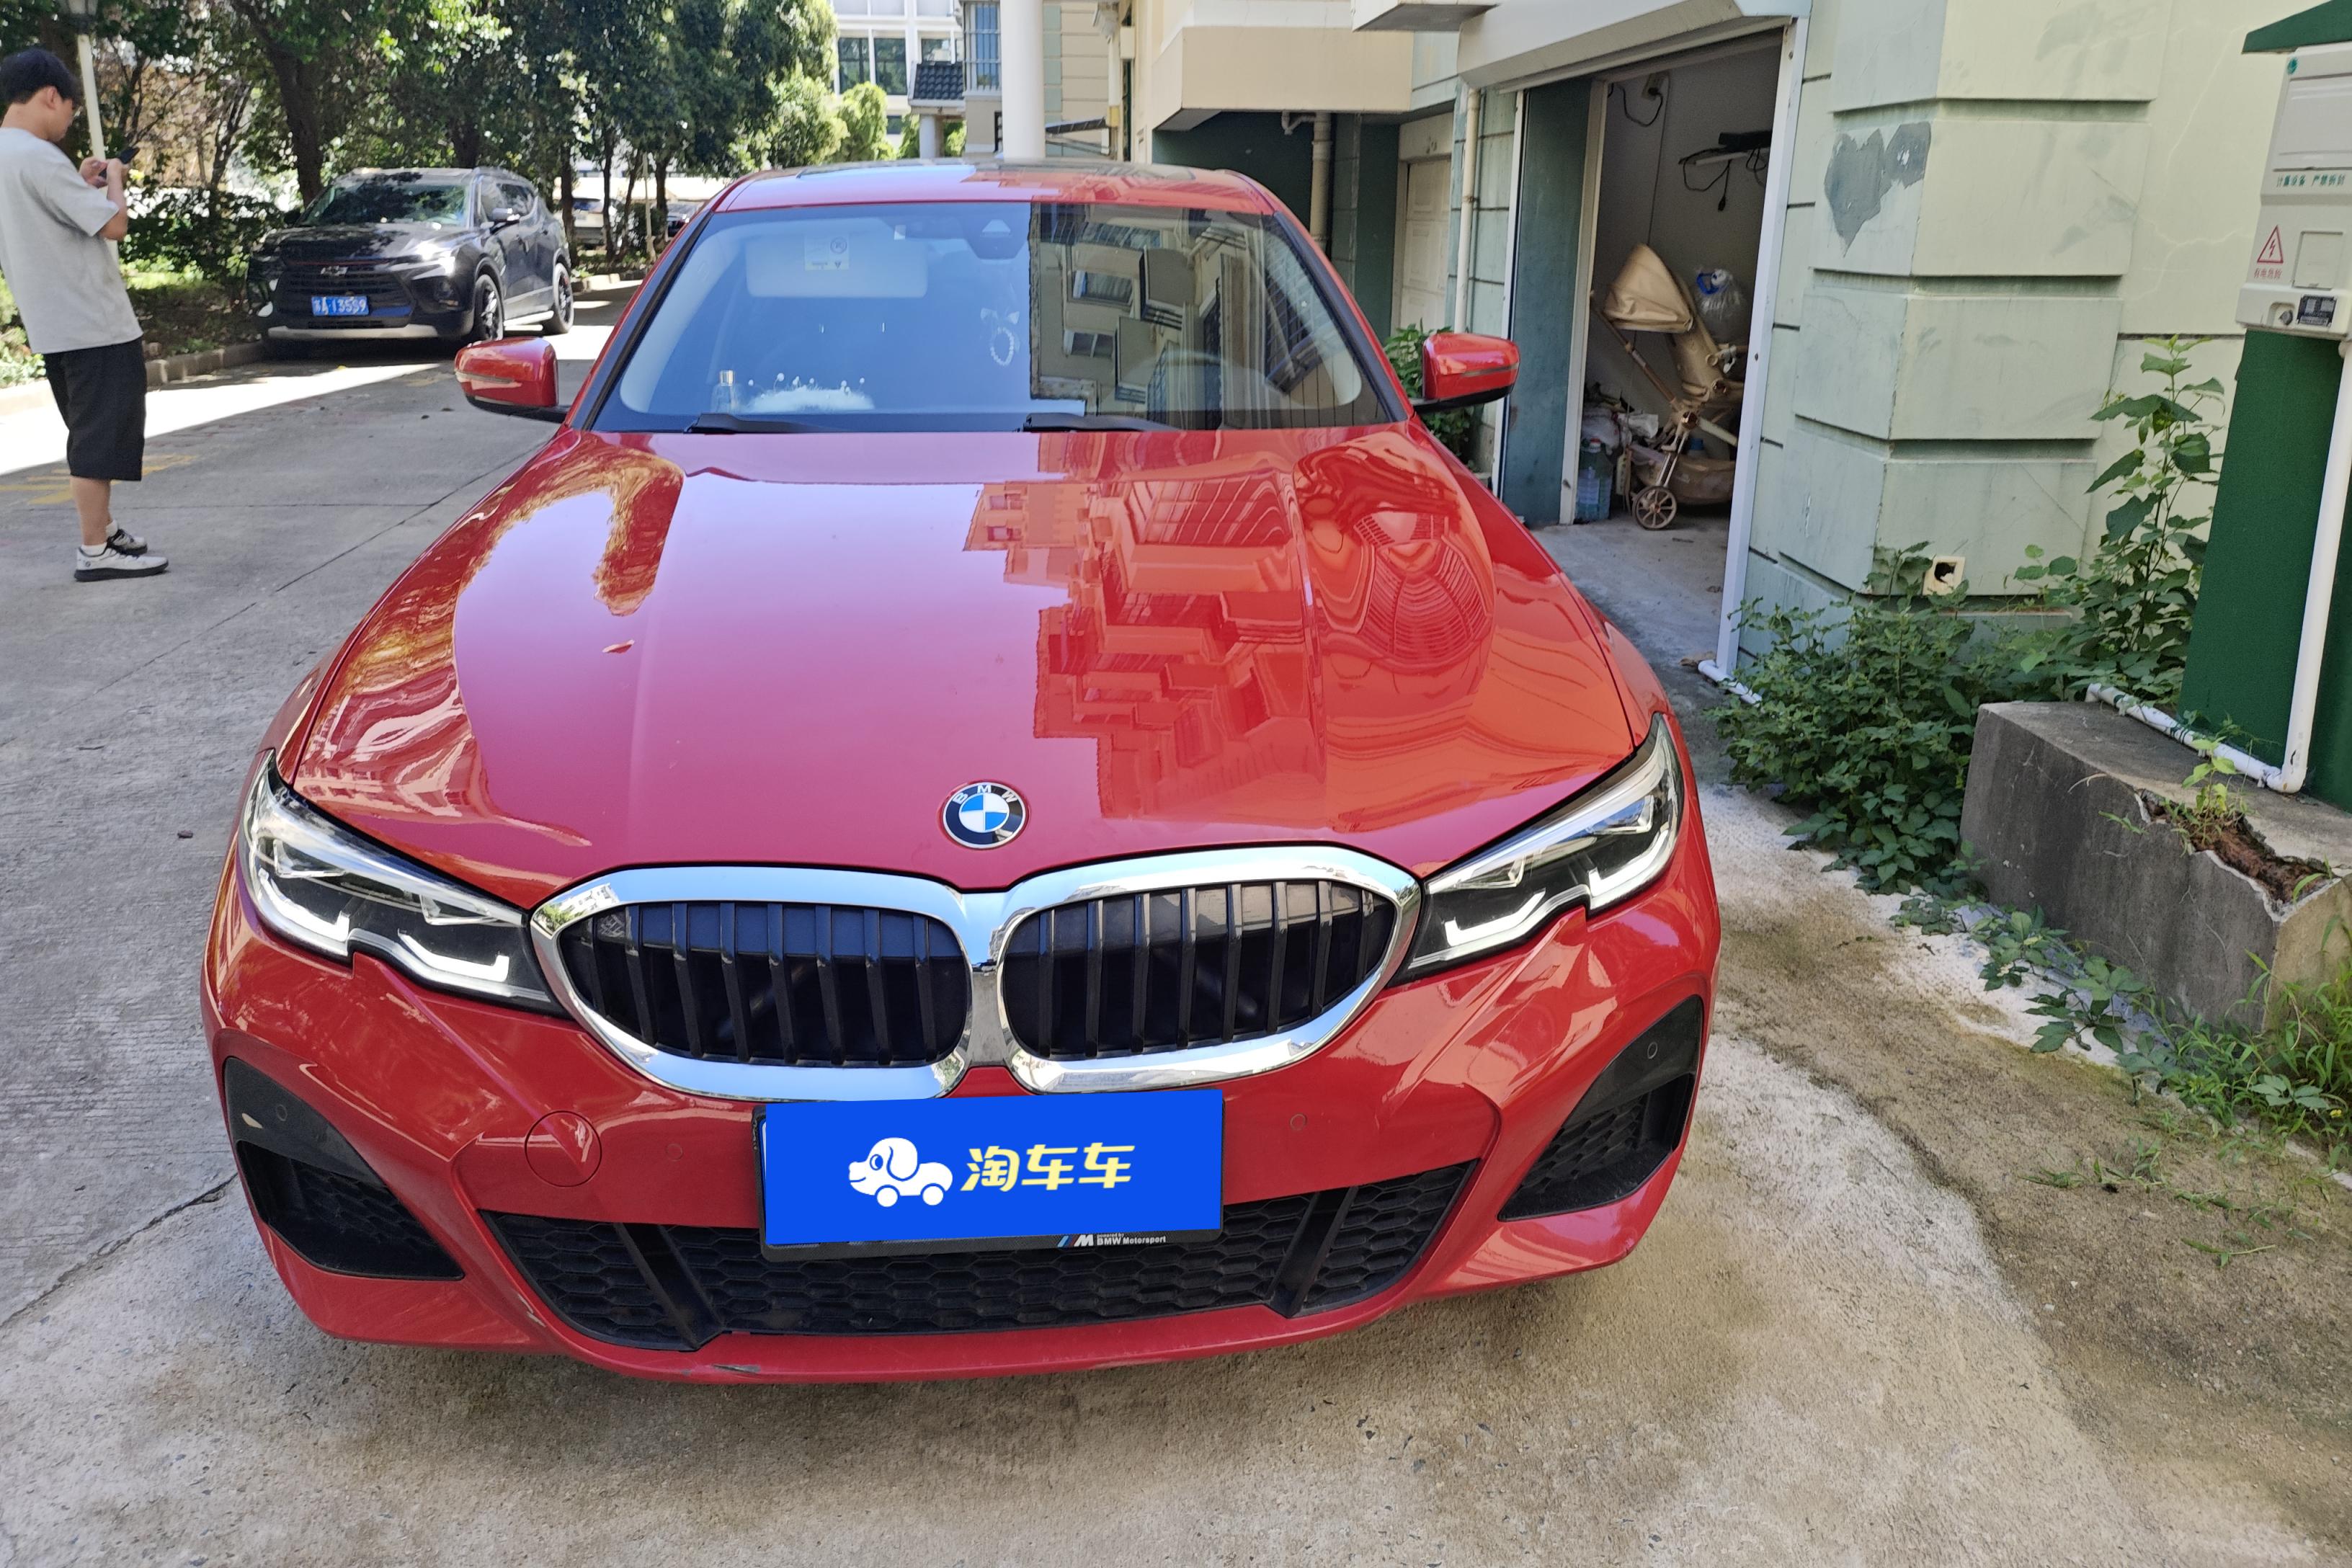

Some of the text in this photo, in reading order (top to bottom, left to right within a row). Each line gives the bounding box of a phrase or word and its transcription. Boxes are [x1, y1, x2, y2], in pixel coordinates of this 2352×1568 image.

[952, 784, 1019, 805] BMW
[1097, 1235, 1167, 1246] BMW Motorsport
